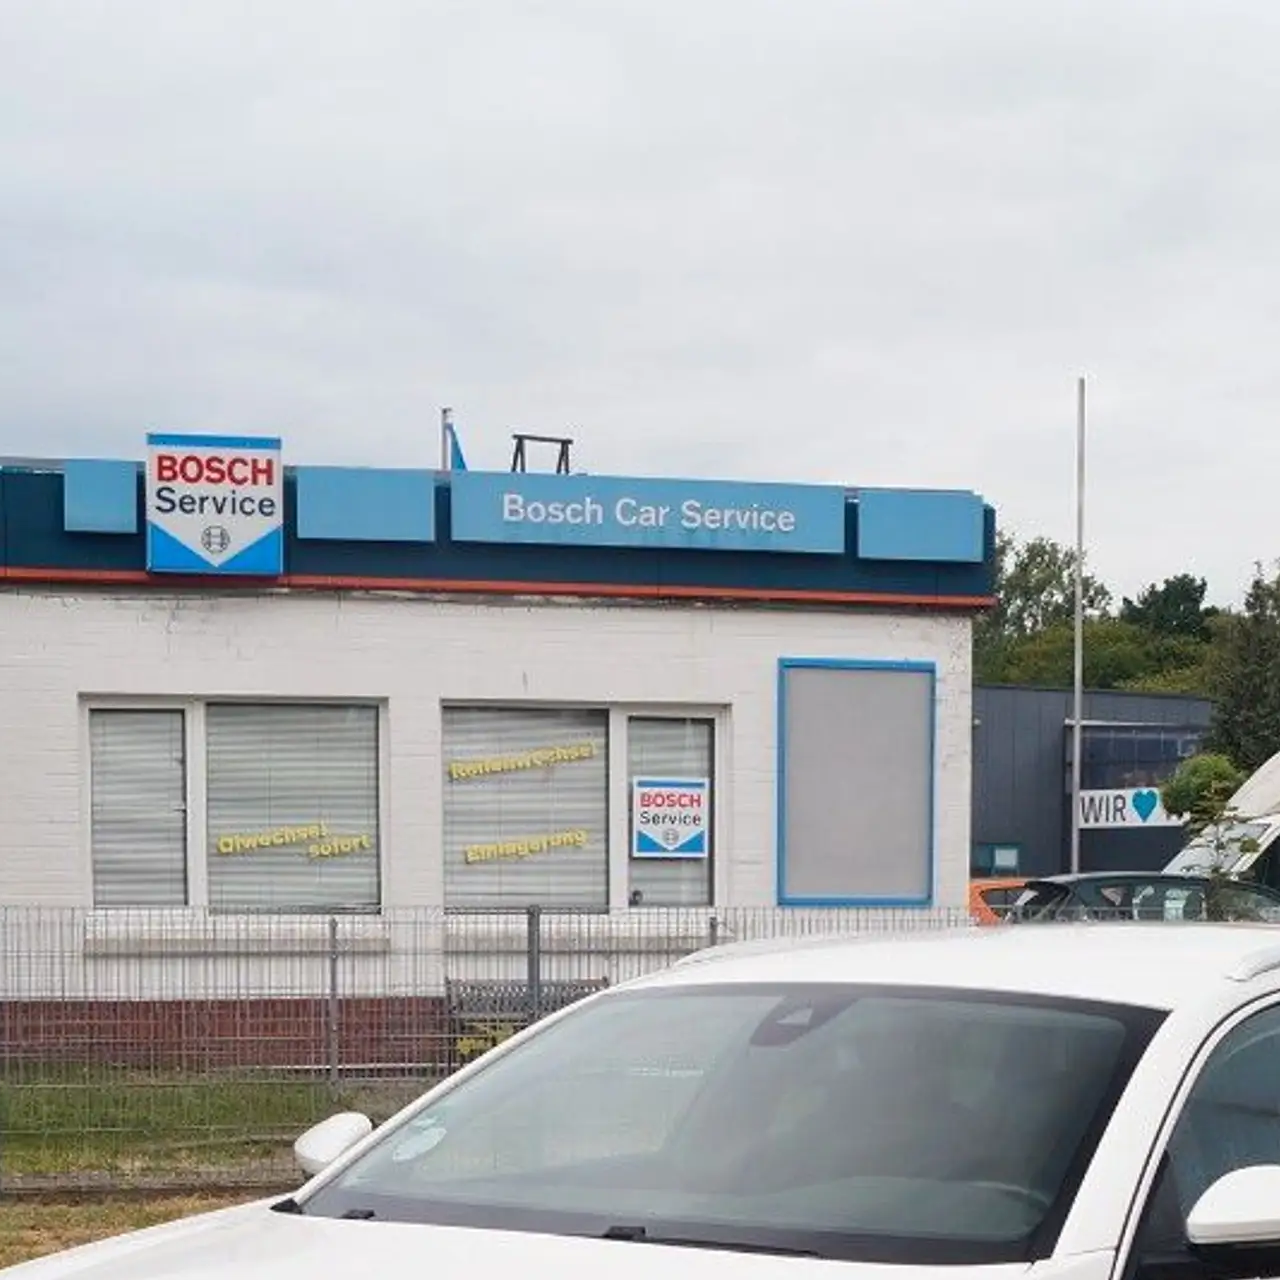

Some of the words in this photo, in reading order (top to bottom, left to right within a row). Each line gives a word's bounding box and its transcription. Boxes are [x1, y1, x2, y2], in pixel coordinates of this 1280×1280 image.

[157, 455, 273, 485] BOSCH
[155, 486, 276, 517] Service
[502, 493, 603, 524] Bosch
[615, 498, 670, 526] Car
[681, 500, 796, 532] Service
[640, 792, 701, 808] BOSCH
[1081, 794, 1126, 823] WIR
[640, 811, 701, 826] Service
